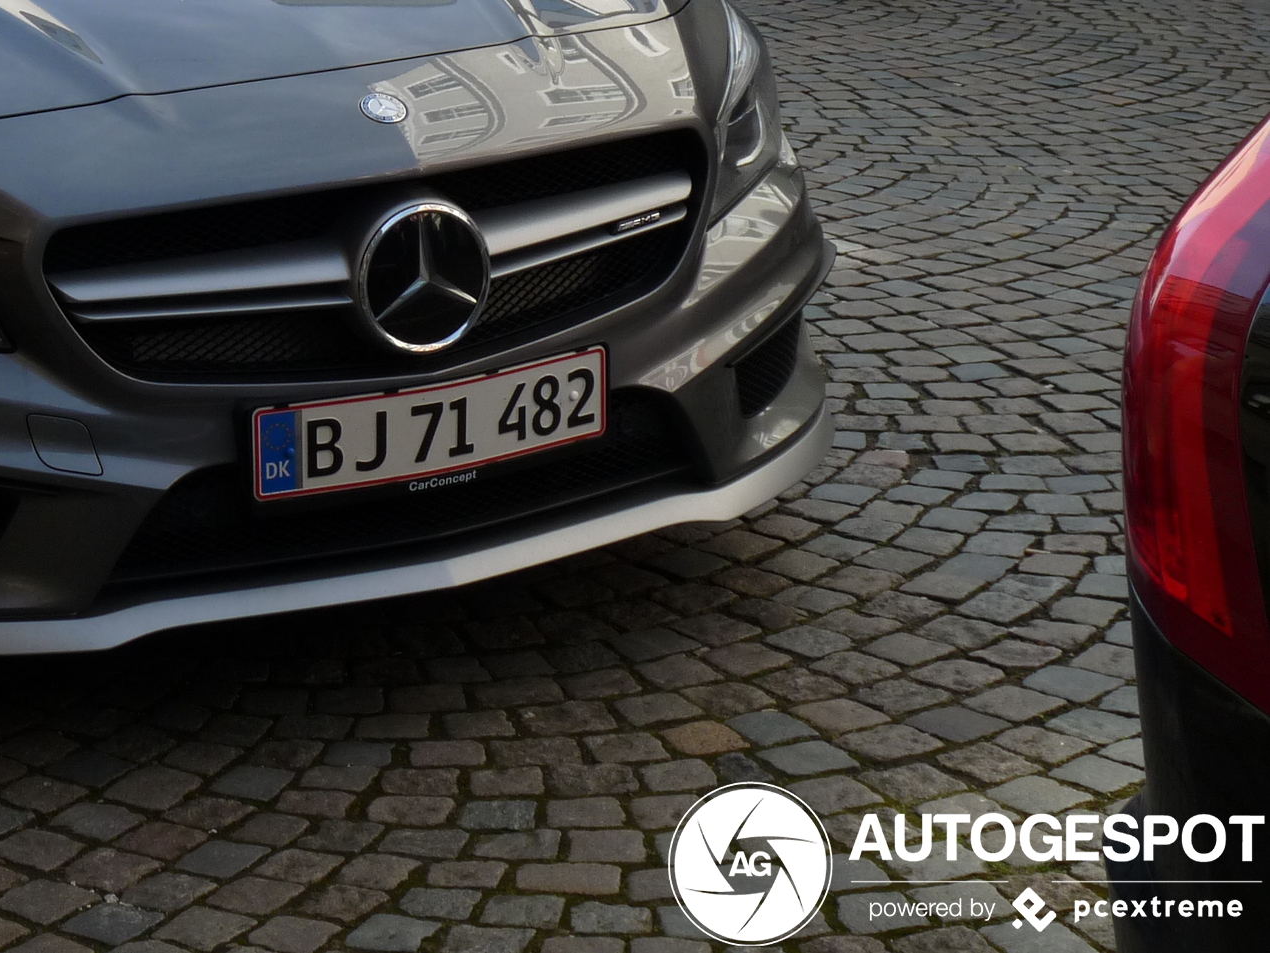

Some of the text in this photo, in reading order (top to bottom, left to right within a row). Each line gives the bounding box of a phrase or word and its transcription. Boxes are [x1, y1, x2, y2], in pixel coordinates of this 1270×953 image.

[307, 368, 595, 479] BJ 71 482
[265, 460, 291, 480] DK
[409, 470, 477, 491] CarConcept
